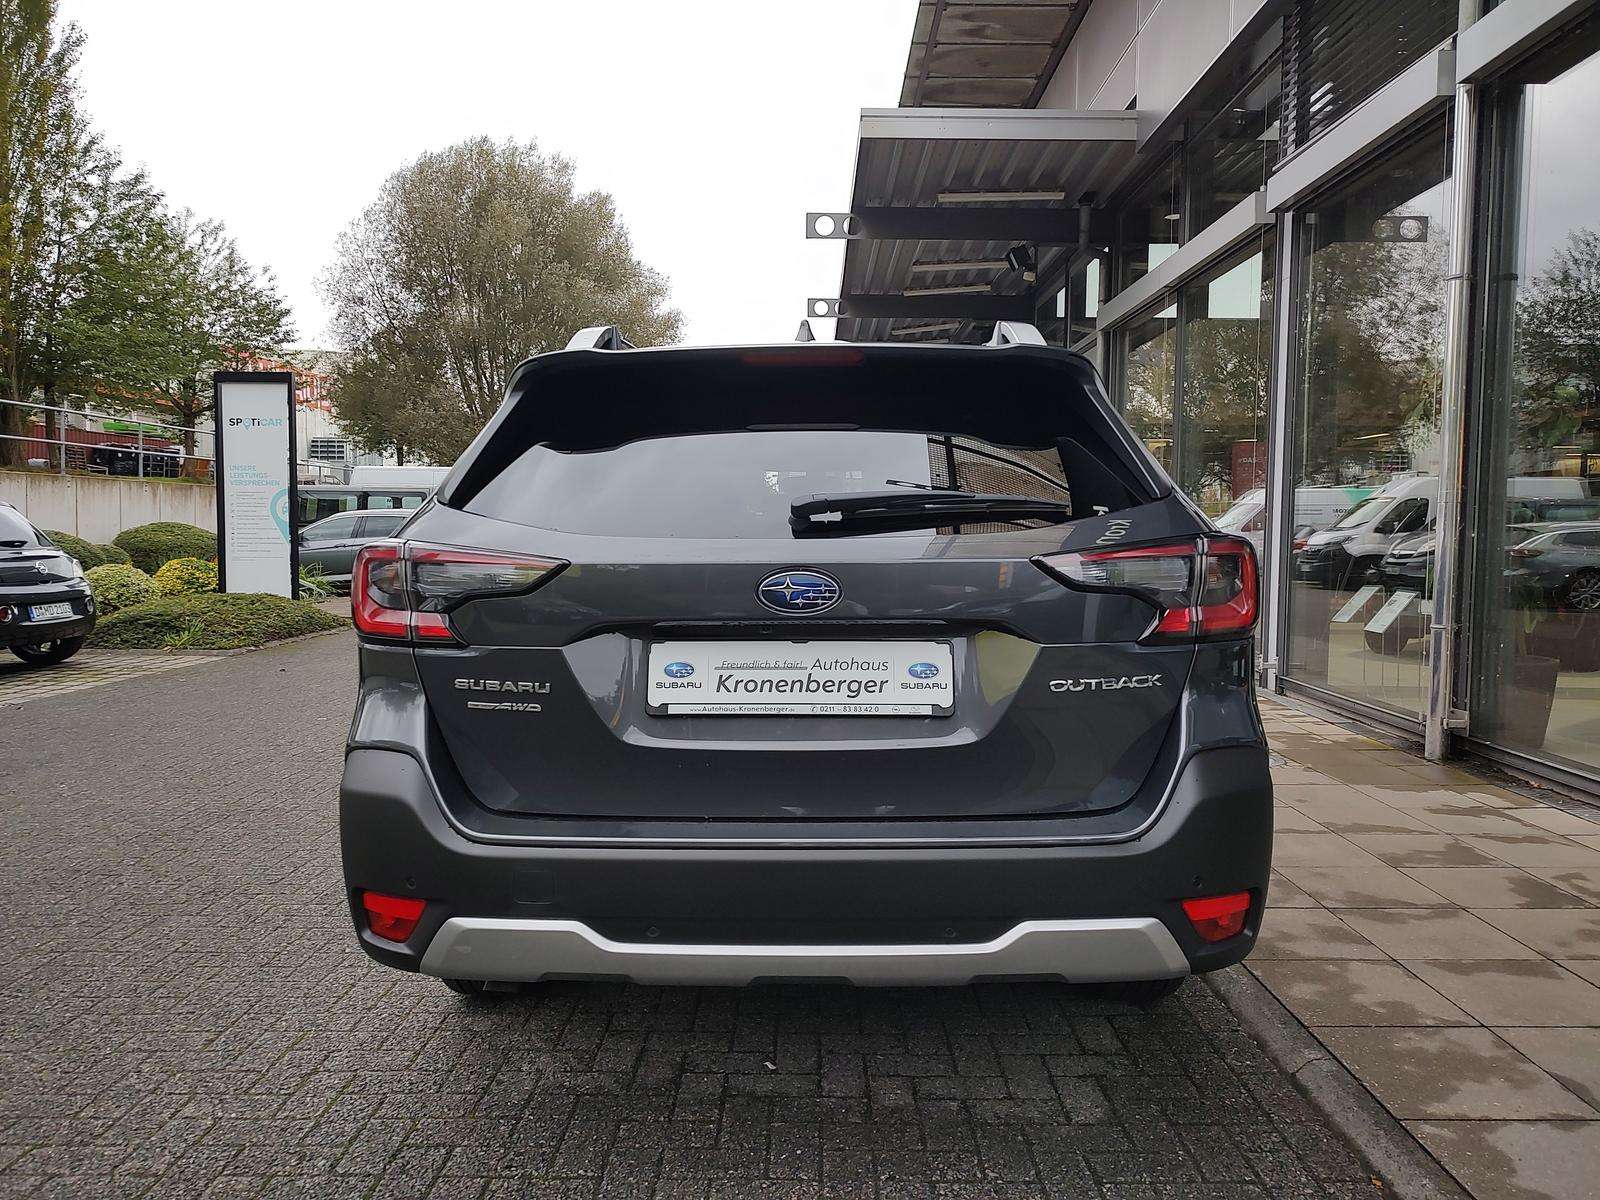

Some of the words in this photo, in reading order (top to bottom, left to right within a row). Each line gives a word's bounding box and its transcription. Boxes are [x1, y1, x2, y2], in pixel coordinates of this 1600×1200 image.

[230, 479, 281, 487] VERSPRECHEN
[720, 660, 771, 669] Freundlich
[773, 660, 780, 669] &
[782, 660, 804, 669] fair!
[810, 657, 889, 671] Autohaus
[454, 678, 551, 694] SUBARU
[655, 681, 702, 689] SUBARU
[716, 673, 889, 699] Kronenberger
[900, 682, 948, 690] SUBARU
[1049, 674, 1163, 692] OUTBACK
[492, 702, 542, 713] AWD
